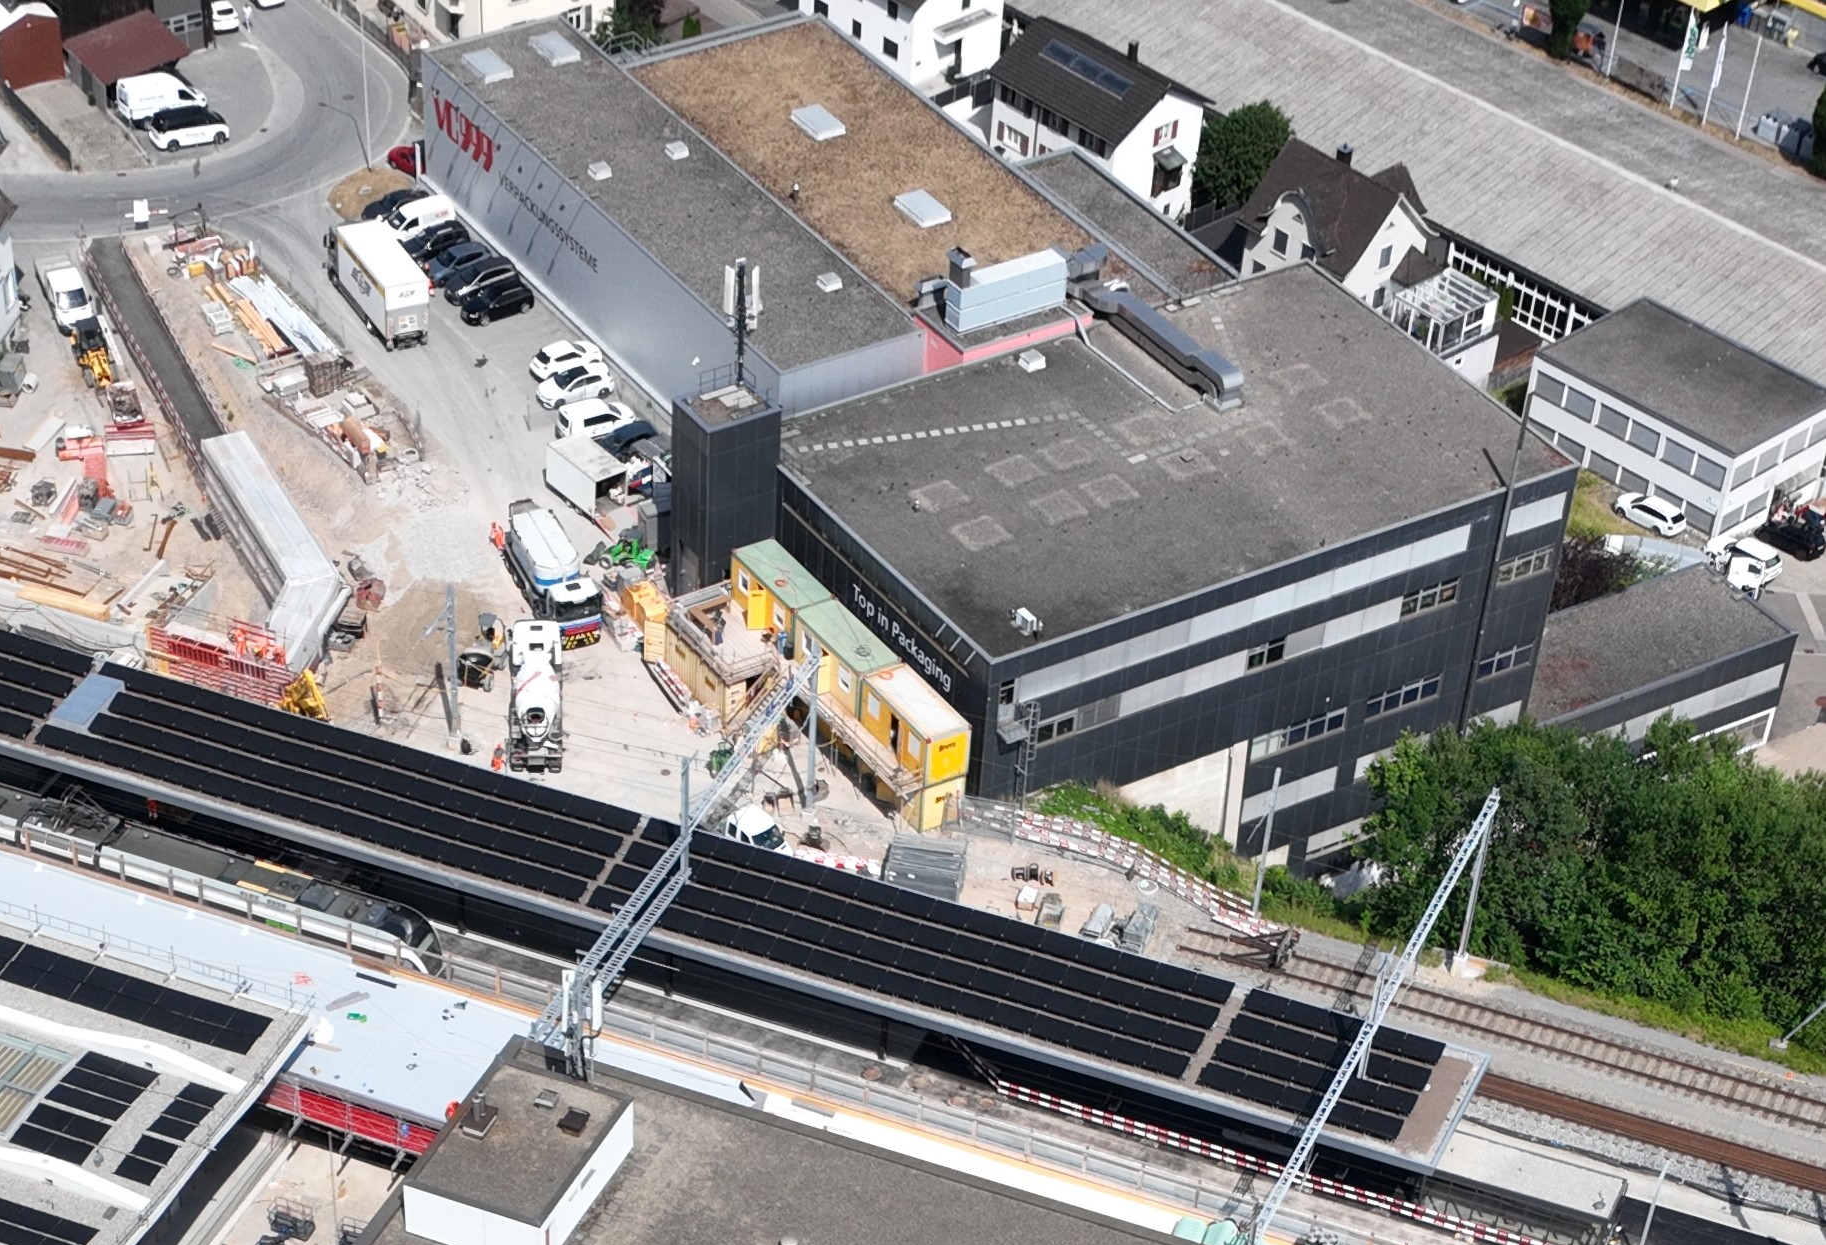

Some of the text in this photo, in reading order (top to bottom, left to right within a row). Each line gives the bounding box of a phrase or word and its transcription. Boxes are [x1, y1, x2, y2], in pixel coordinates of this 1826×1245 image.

[497, 170, 599, 274] VERPACKUNGSSYSTEME
[852, 583, 952, 693] Top in Packaging
